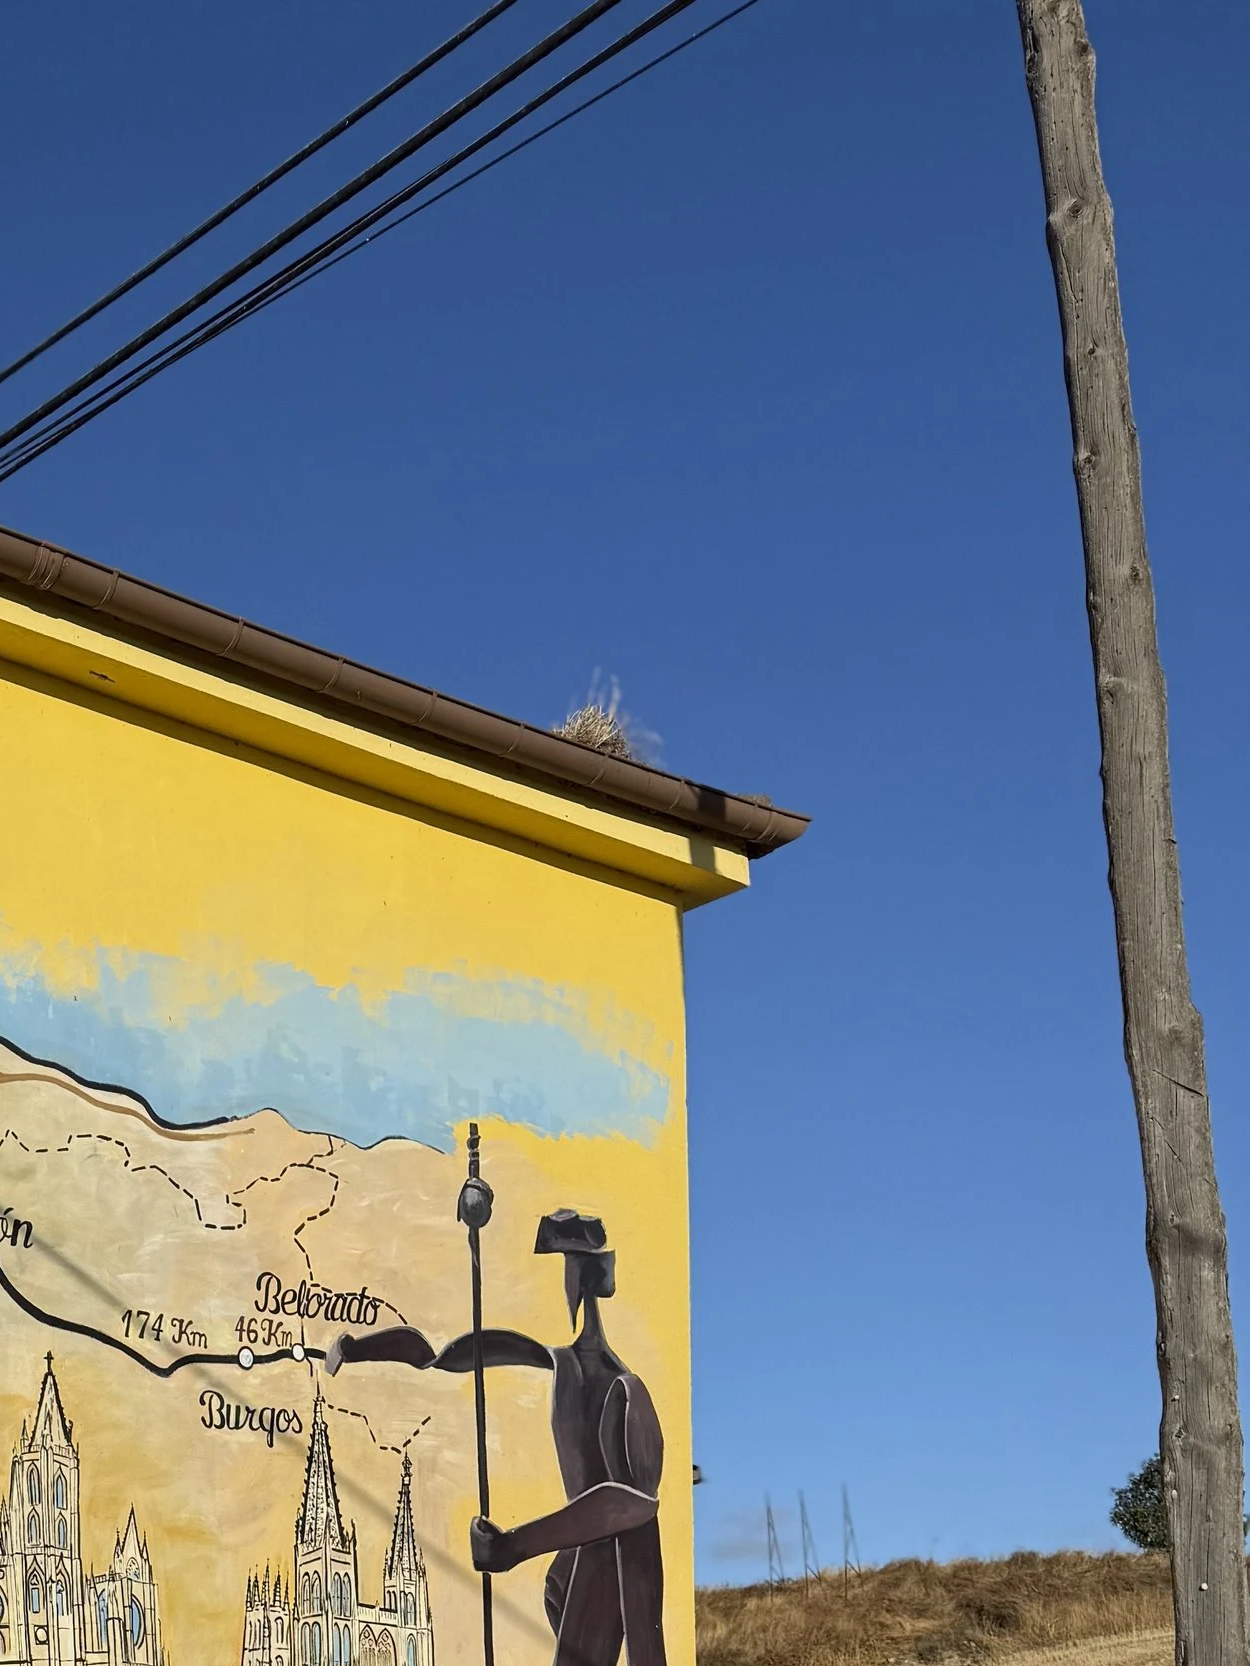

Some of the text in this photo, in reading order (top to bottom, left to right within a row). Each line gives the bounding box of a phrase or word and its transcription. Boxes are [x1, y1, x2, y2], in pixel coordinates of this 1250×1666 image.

[254, 1271, 380, 1326] Belorado
[121, 1309, 208, 1349] 174 Km
[234, 1315, 293, 1347] 46 Km
[199, 1390, 304, 1448] Burgos
